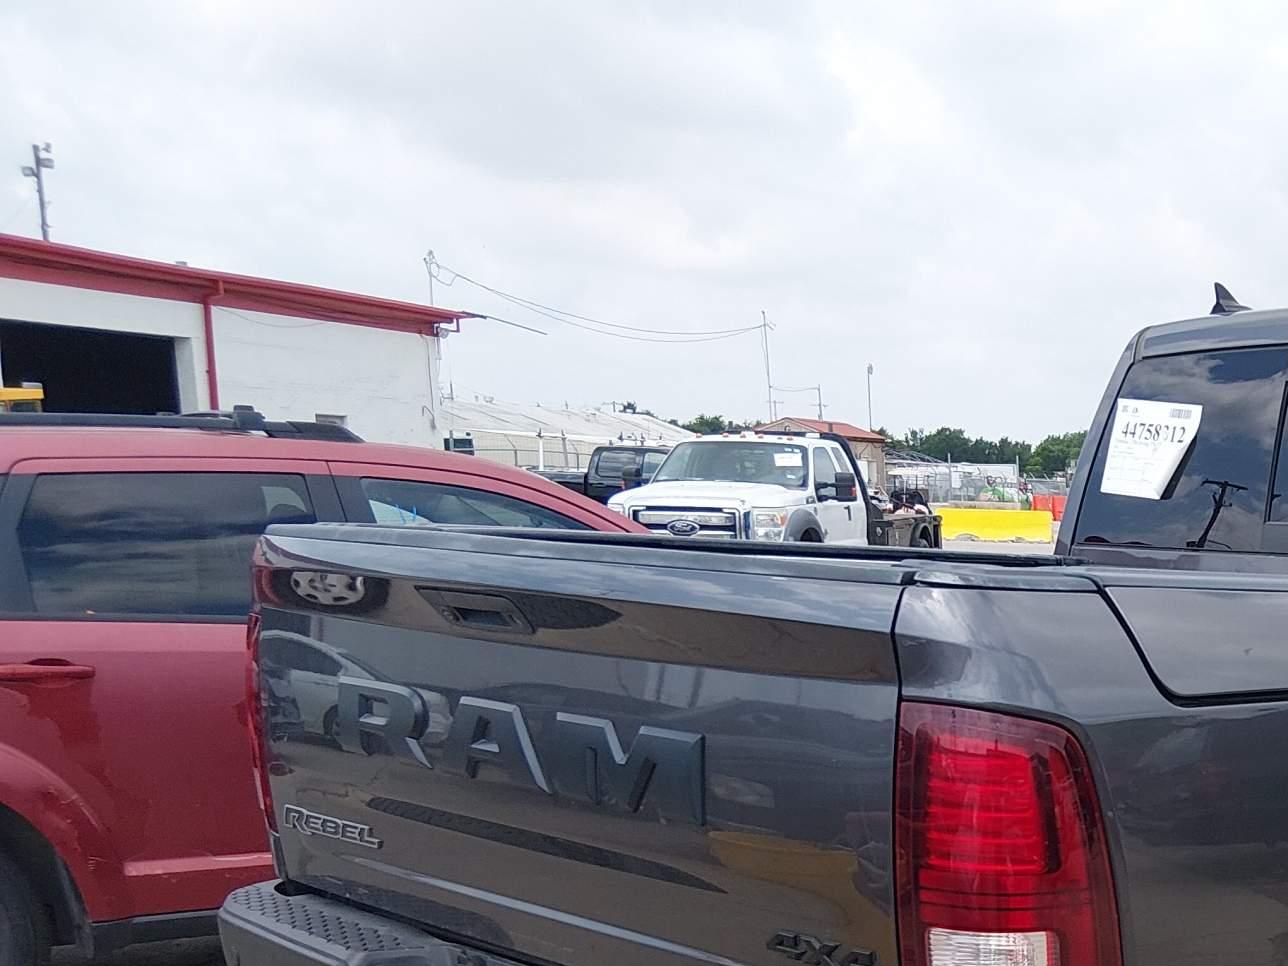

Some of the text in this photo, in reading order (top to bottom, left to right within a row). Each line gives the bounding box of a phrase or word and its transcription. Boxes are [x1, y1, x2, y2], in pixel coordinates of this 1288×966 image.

[1121, 421, 1187, 444] 44758312
[337, 675, 707, 828] RAM
[283, 804, 385, 849] REBEL
